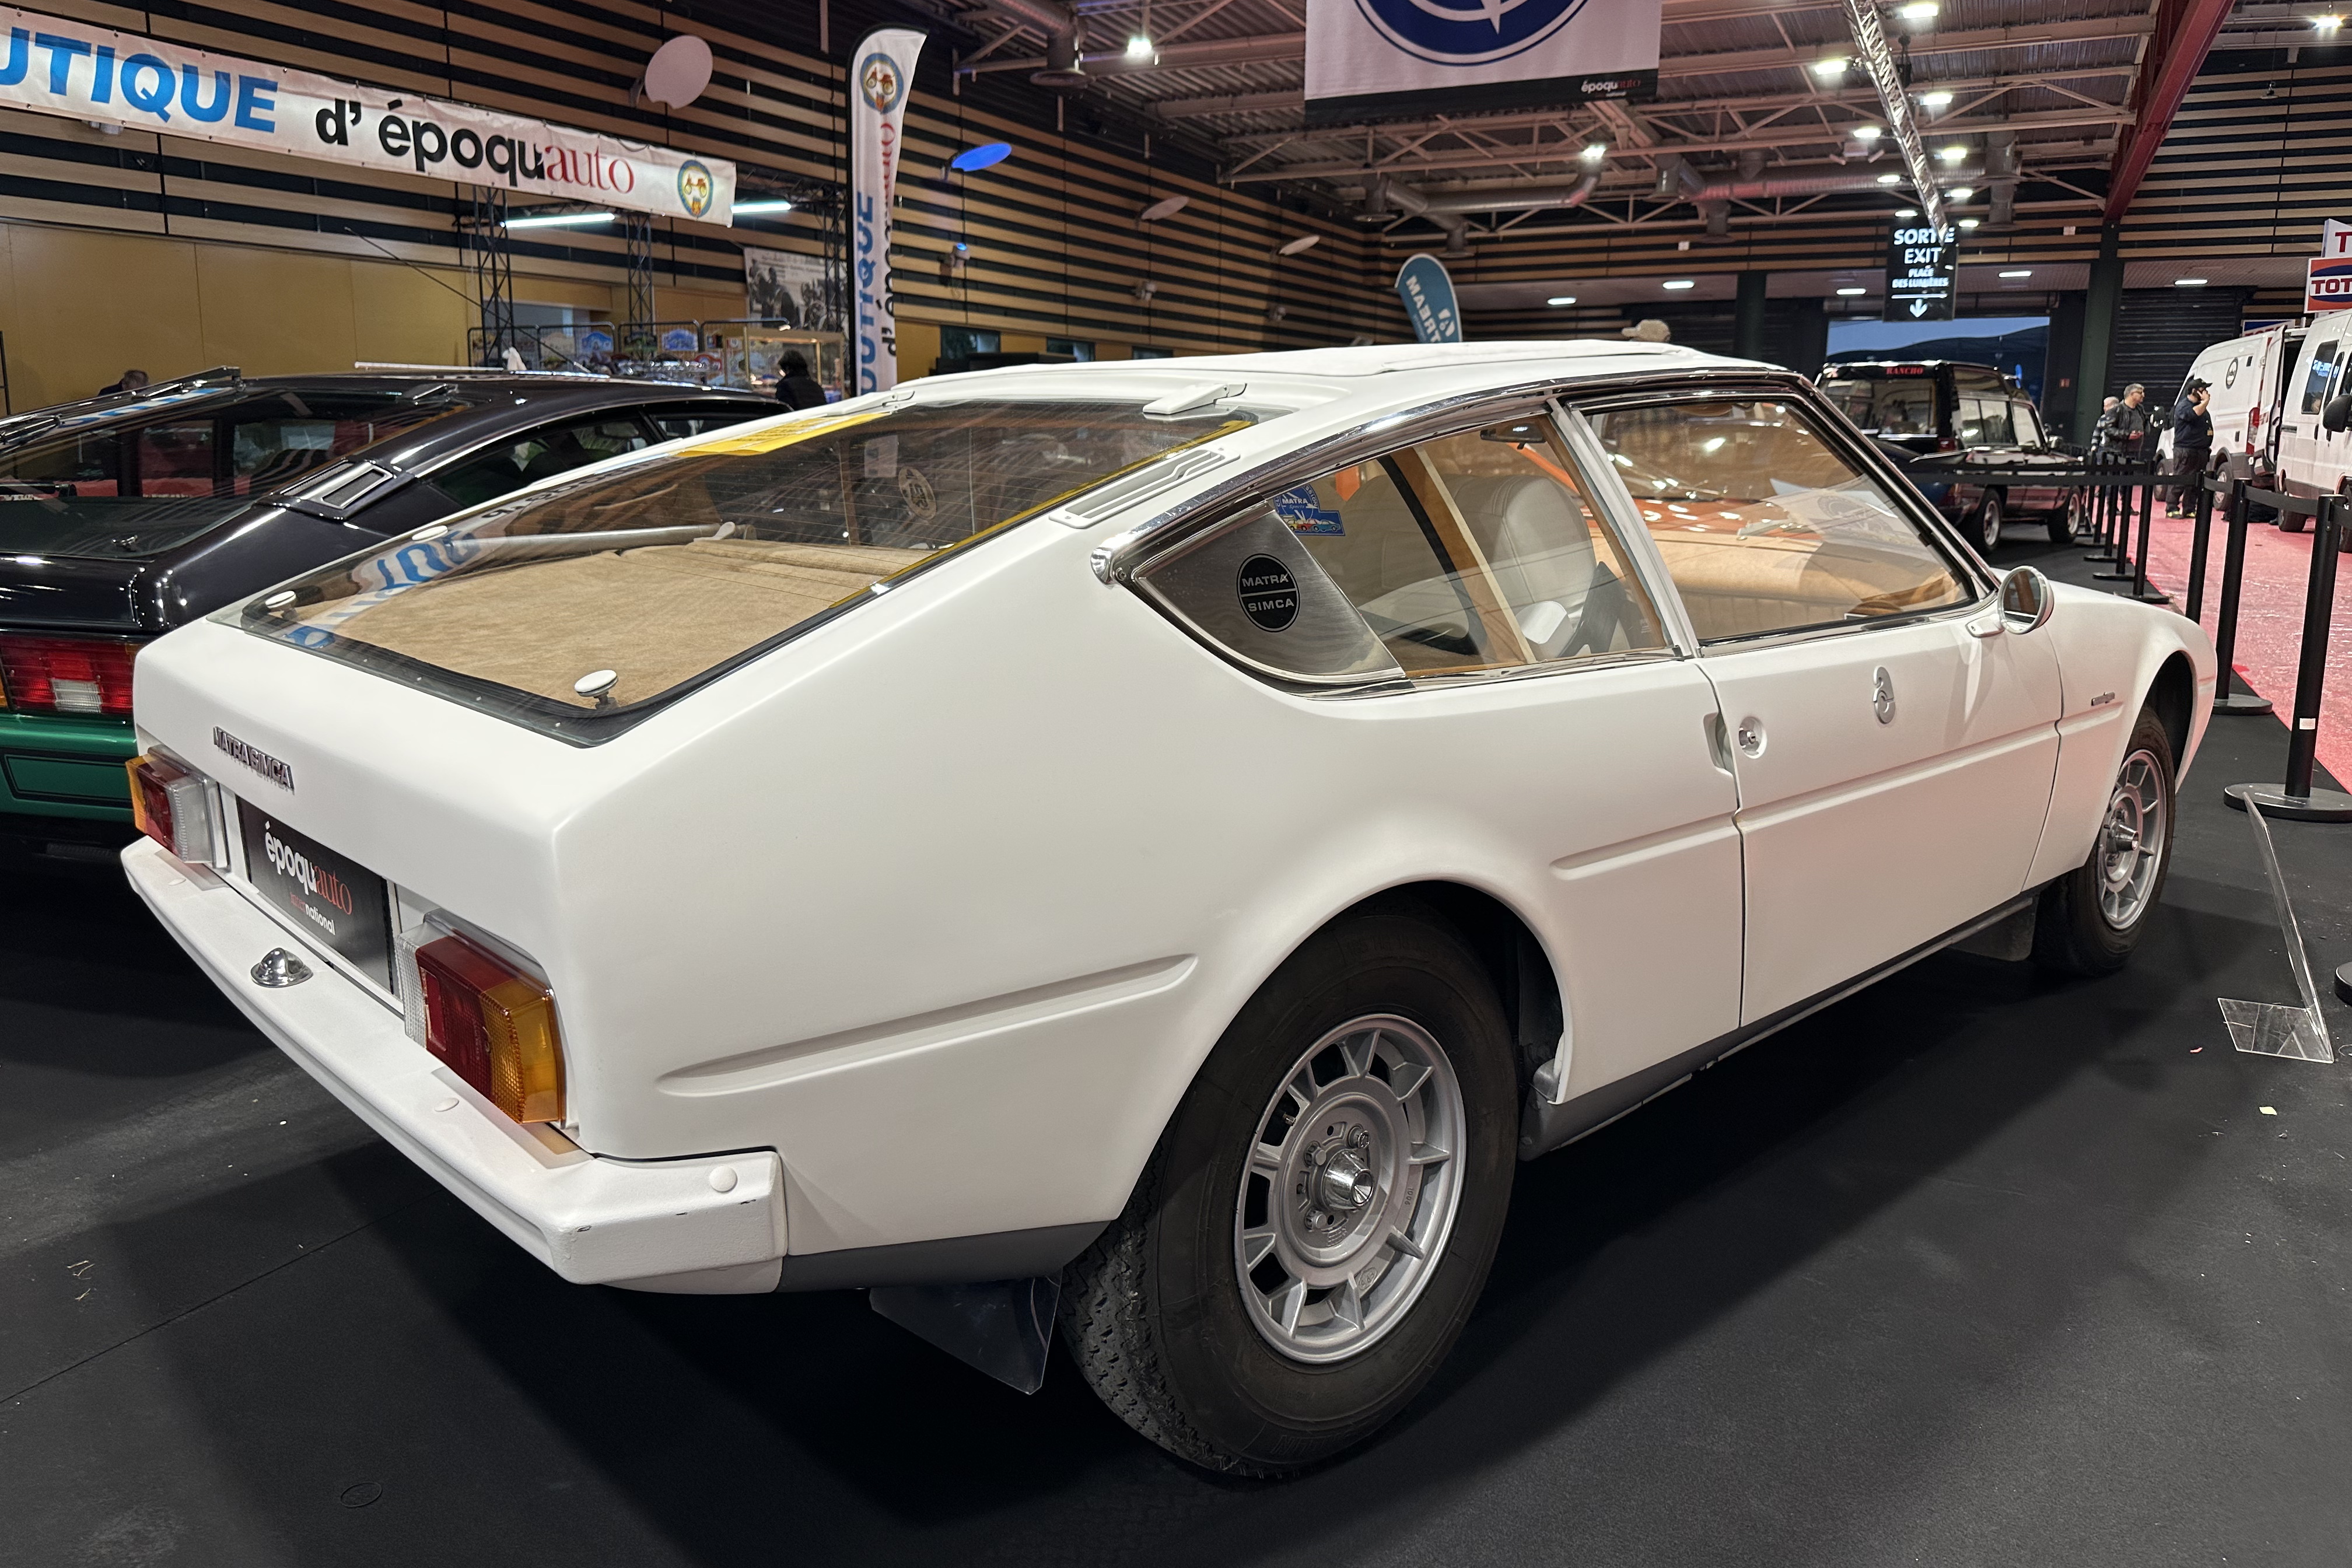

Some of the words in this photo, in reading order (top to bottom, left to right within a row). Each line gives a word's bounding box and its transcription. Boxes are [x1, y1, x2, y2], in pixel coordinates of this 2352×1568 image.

[1894, 227, 1955, 246] SORTE
[1904, 247, 1943, 264] EXIT
[1885, 366, 1924, 375] RANCHO
[1241, 574, 1289, 587] MATRA
[1248, 598, 1294, 612] SIMCA
[265, 820, 352, 915] époquauto
[289, 891, 336, 936] international
